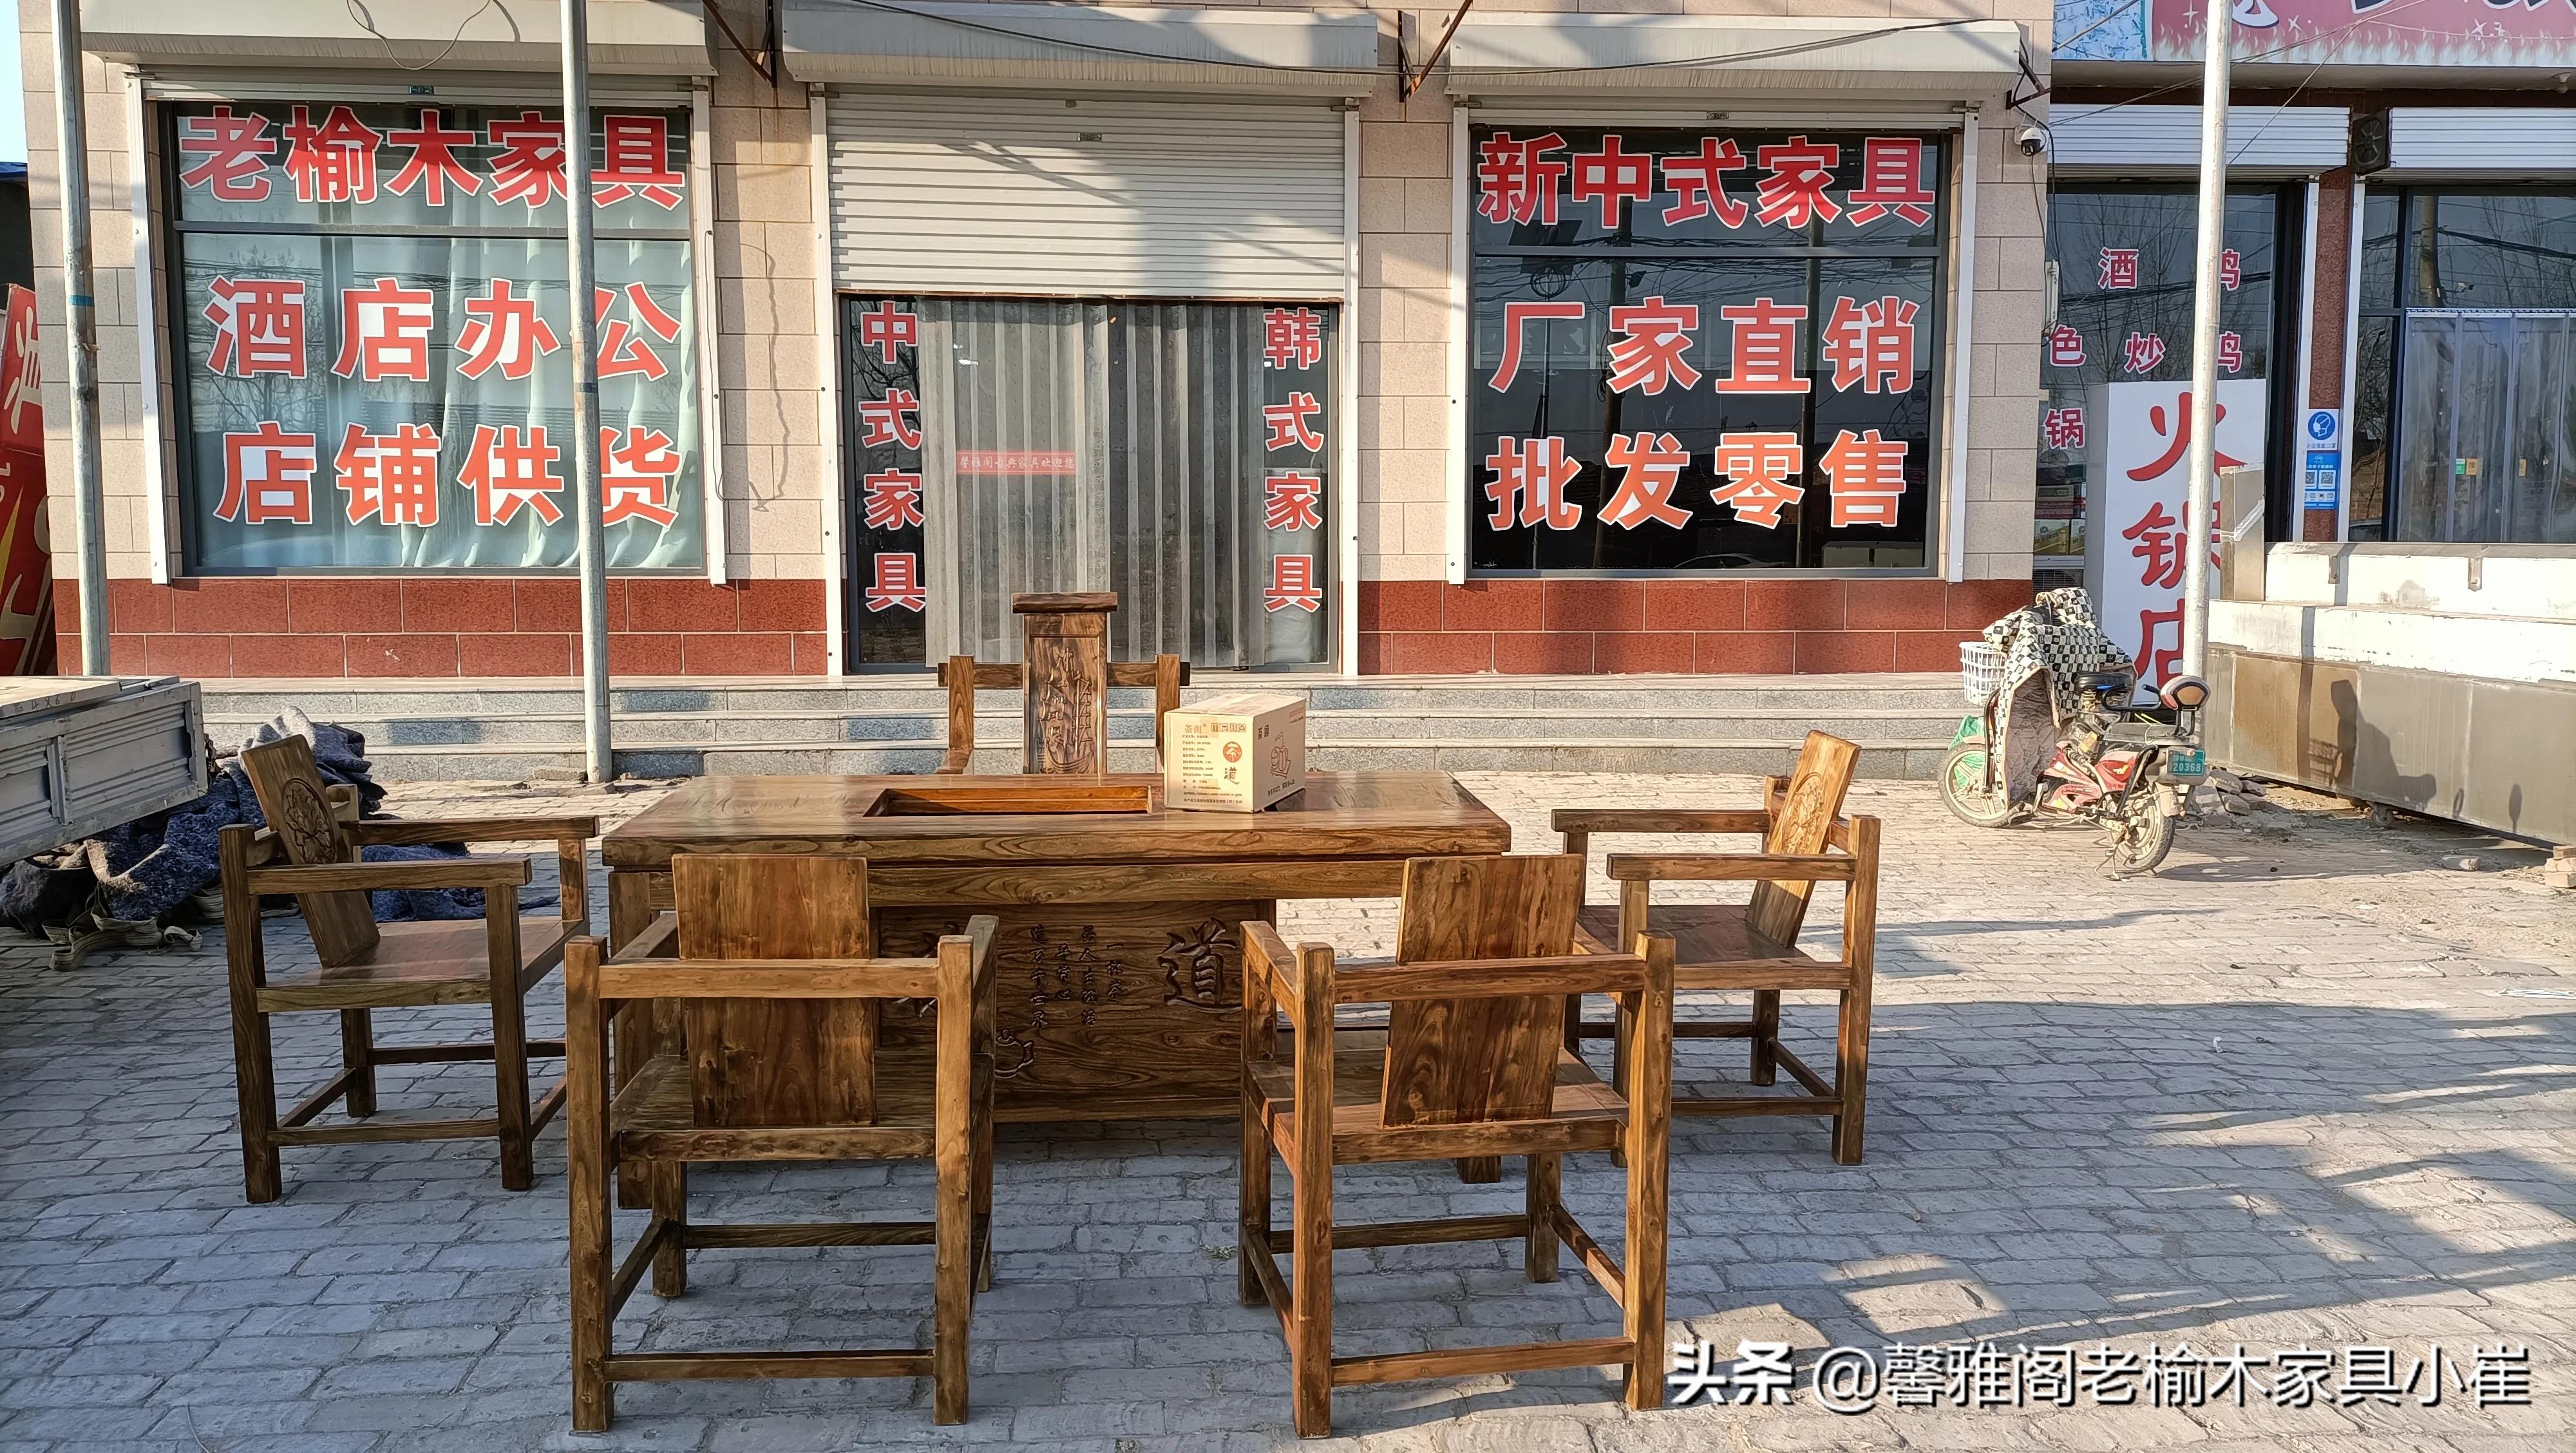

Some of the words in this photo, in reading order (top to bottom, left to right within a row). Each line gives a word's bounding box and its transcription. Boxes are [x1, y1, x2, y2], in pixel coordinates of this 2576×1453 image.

[179, 105, 686, 211] 老榆木家具
[1477, 132, 1936, 229] 新中式家具
[203, 276, 683, 383] 酒店办公
[1488, 296, 1921, 396] 厂家直销
[213, 420, 684, 528] 店铺供货
[858, 300, 927, 613] 中式家具
[1262, 306, 1325, 613] 韩式家具
[1484, 430, 1909, 531] 批发零售
